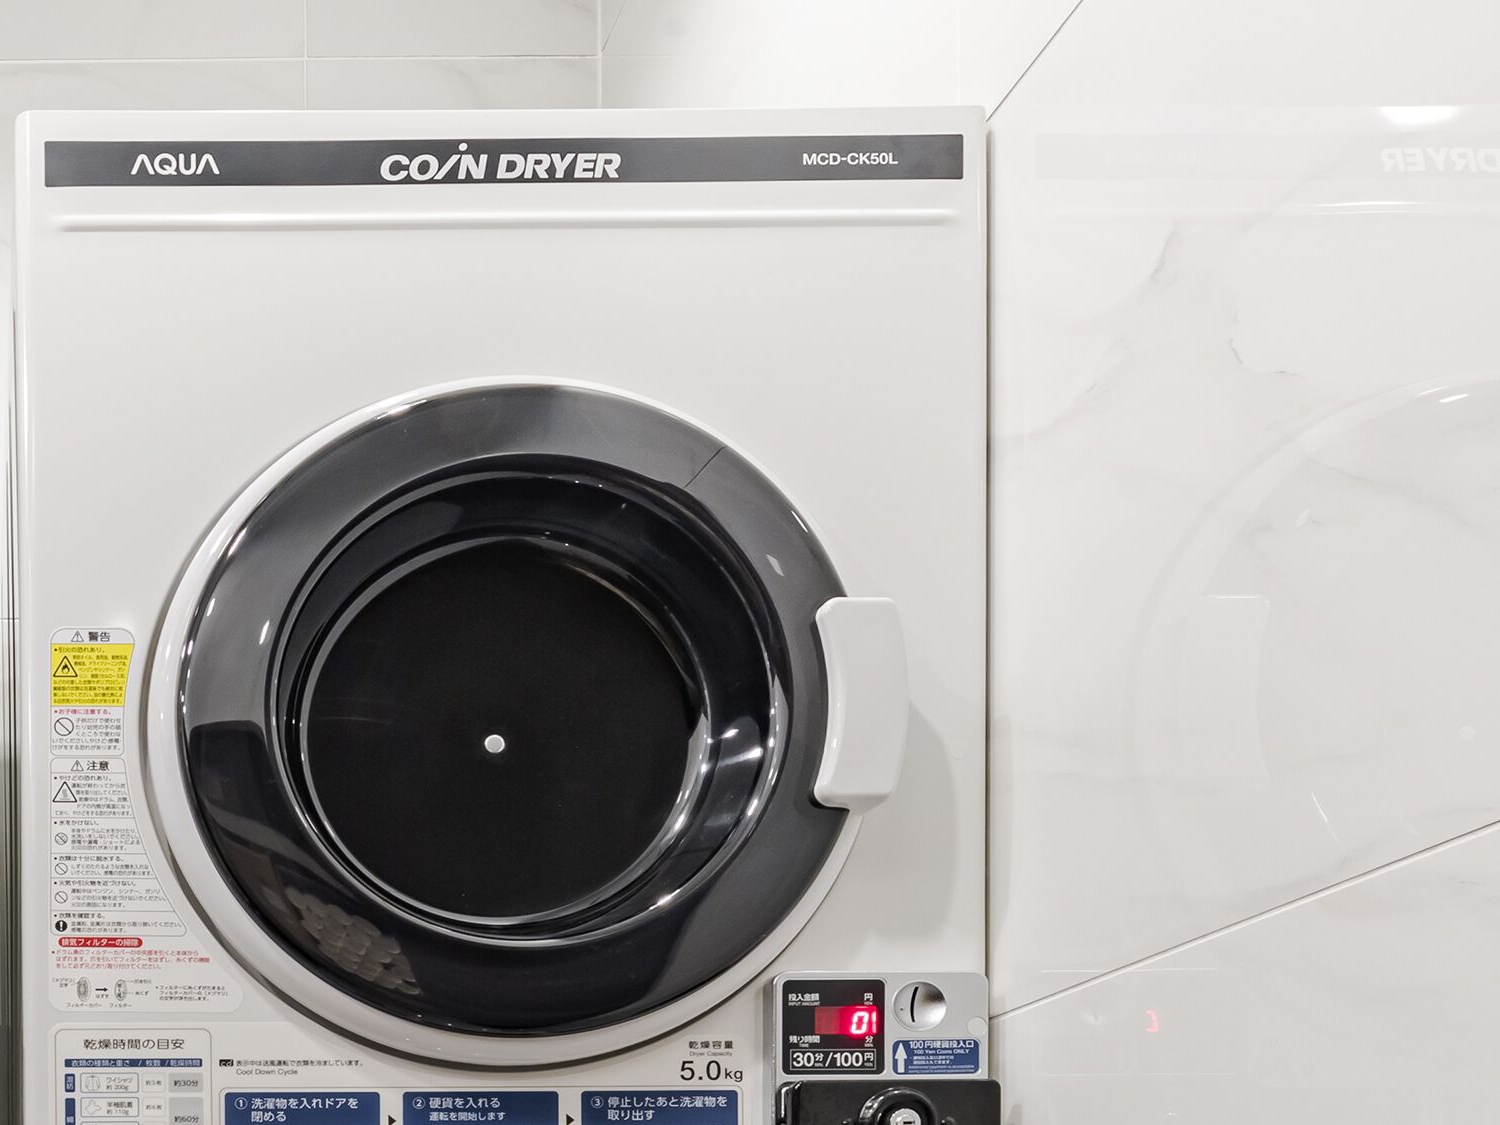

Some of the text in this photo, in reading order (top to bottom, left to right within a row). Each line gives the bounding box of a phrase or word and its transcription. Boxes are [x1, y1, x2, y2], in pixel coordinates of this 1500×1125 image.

[132, 151, 220, 175] AQUA
[802, 151, 899, 166] MCD-CK50L
[496, 151, 622, 180] DRYER
[88, 632, 110, 642] 警告
[87, 761, 109, 771] 注意
[788, 993, 819, 1001] 投入金額
[83, 1039, 185, 1050] 乾燥時間の目安
[789, 1035, 820, 1043] 残り時間
[689, 1041, 733, 1050] 乾燥容量
[251, 1098, 358, 1109] 洗濯物を入れドアを
[429, 1097, 500, 1109] 硬貨を入れる
[608, 1096, 727, 1108] 停止したあと洗濯物を
[251, 1111, 286, 1122] 閉める
[429, 1112, 506, 1121] 運転を開始します
[608, 1109, 655, 1121] 取り出す
